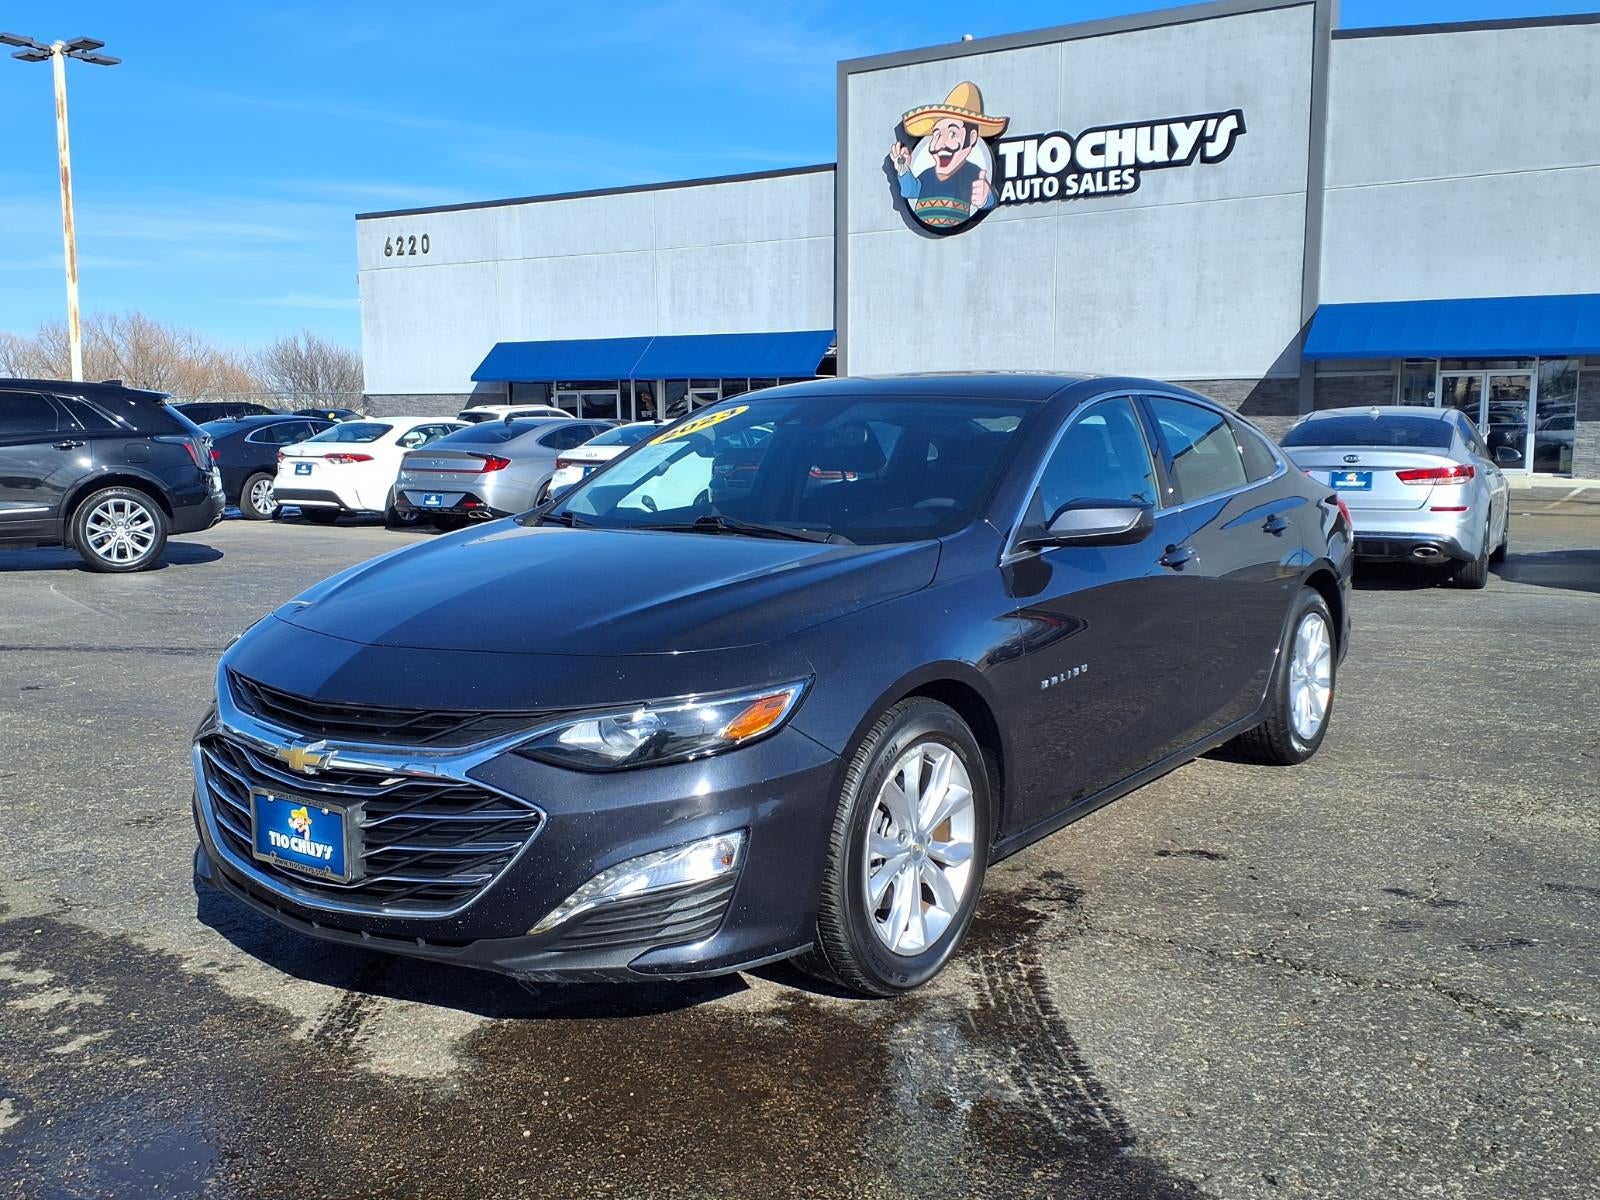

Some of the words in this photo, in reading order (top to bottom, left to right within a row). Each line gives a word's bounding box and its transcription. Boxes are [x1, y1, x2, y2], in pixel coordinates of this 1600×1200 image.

[1000, 138, 1071, 179] TIO
[1075, 114, 1238, 170] CHUY'S
[1000, 176, 1060, 203] AUTO
[1065, 168, 1136, 196] SALES
[384, 233, 430, 257] 6220
[1040, 663, 1088, 690] MALIBU
[268, 830, 290, 849] TIO
[290, 838, 333, 860] CHUY'S
